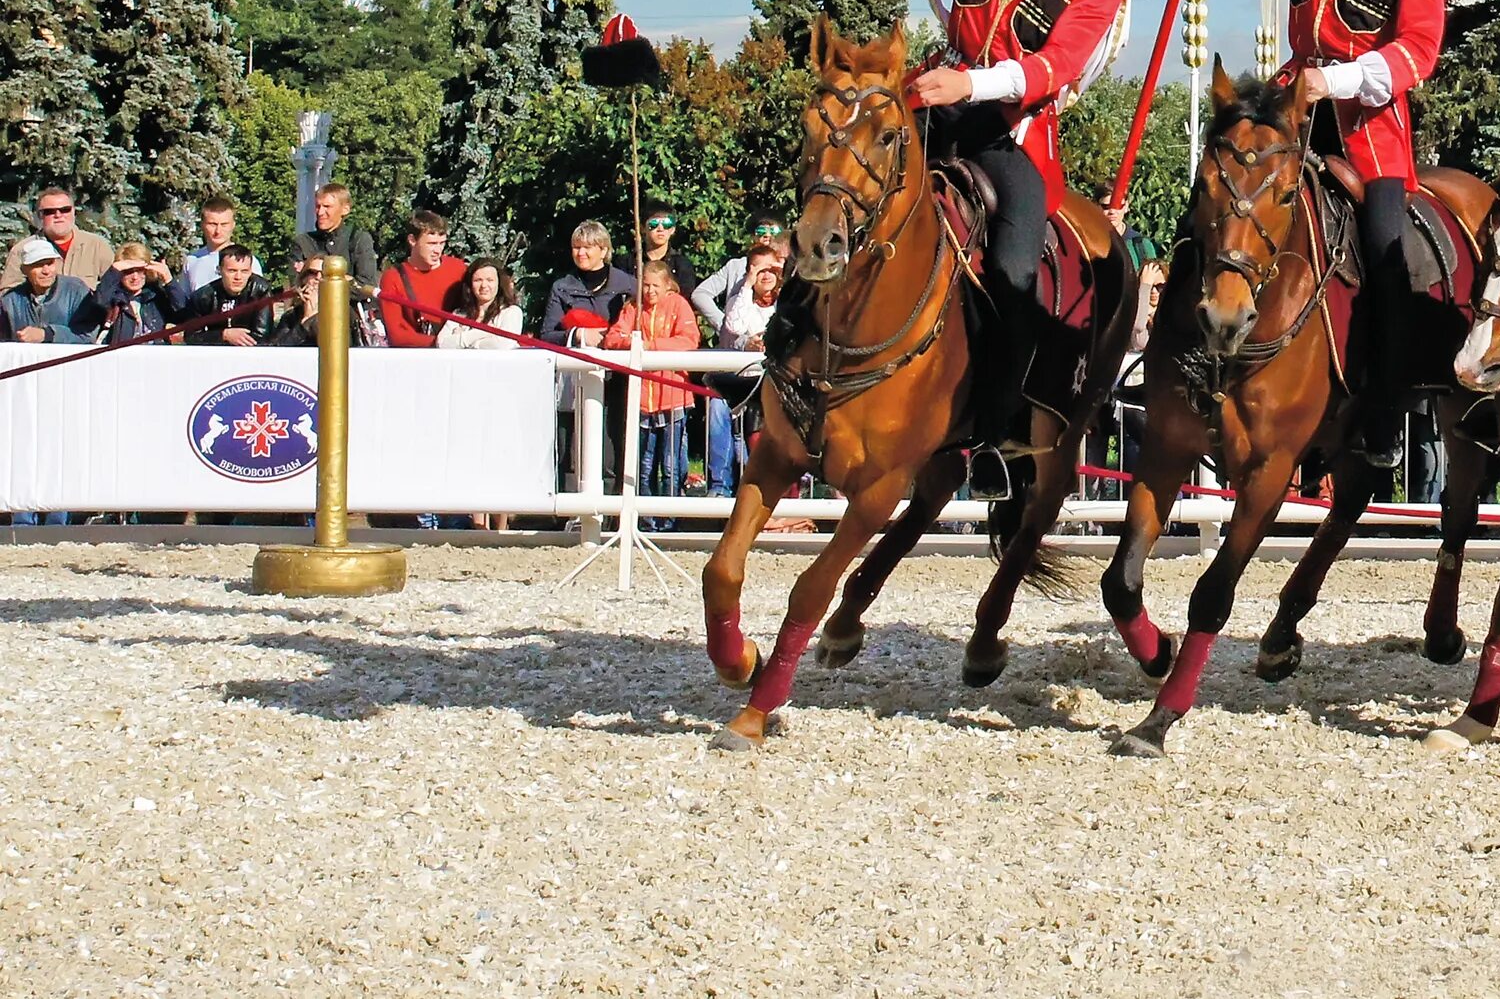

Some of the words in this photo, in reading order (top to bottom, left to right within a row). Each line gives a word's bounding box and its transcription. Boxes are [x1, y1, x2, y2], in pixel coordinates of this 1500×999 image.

[204, 381, 278, 411] КРЕМЛЕВСКАЯ
[279, 383, 316, 411] ШКОЛА
[219, 459, 273, 477] ВЕРХОВОЙ
[274, 458, 302, 475] ЕЗДЫ
